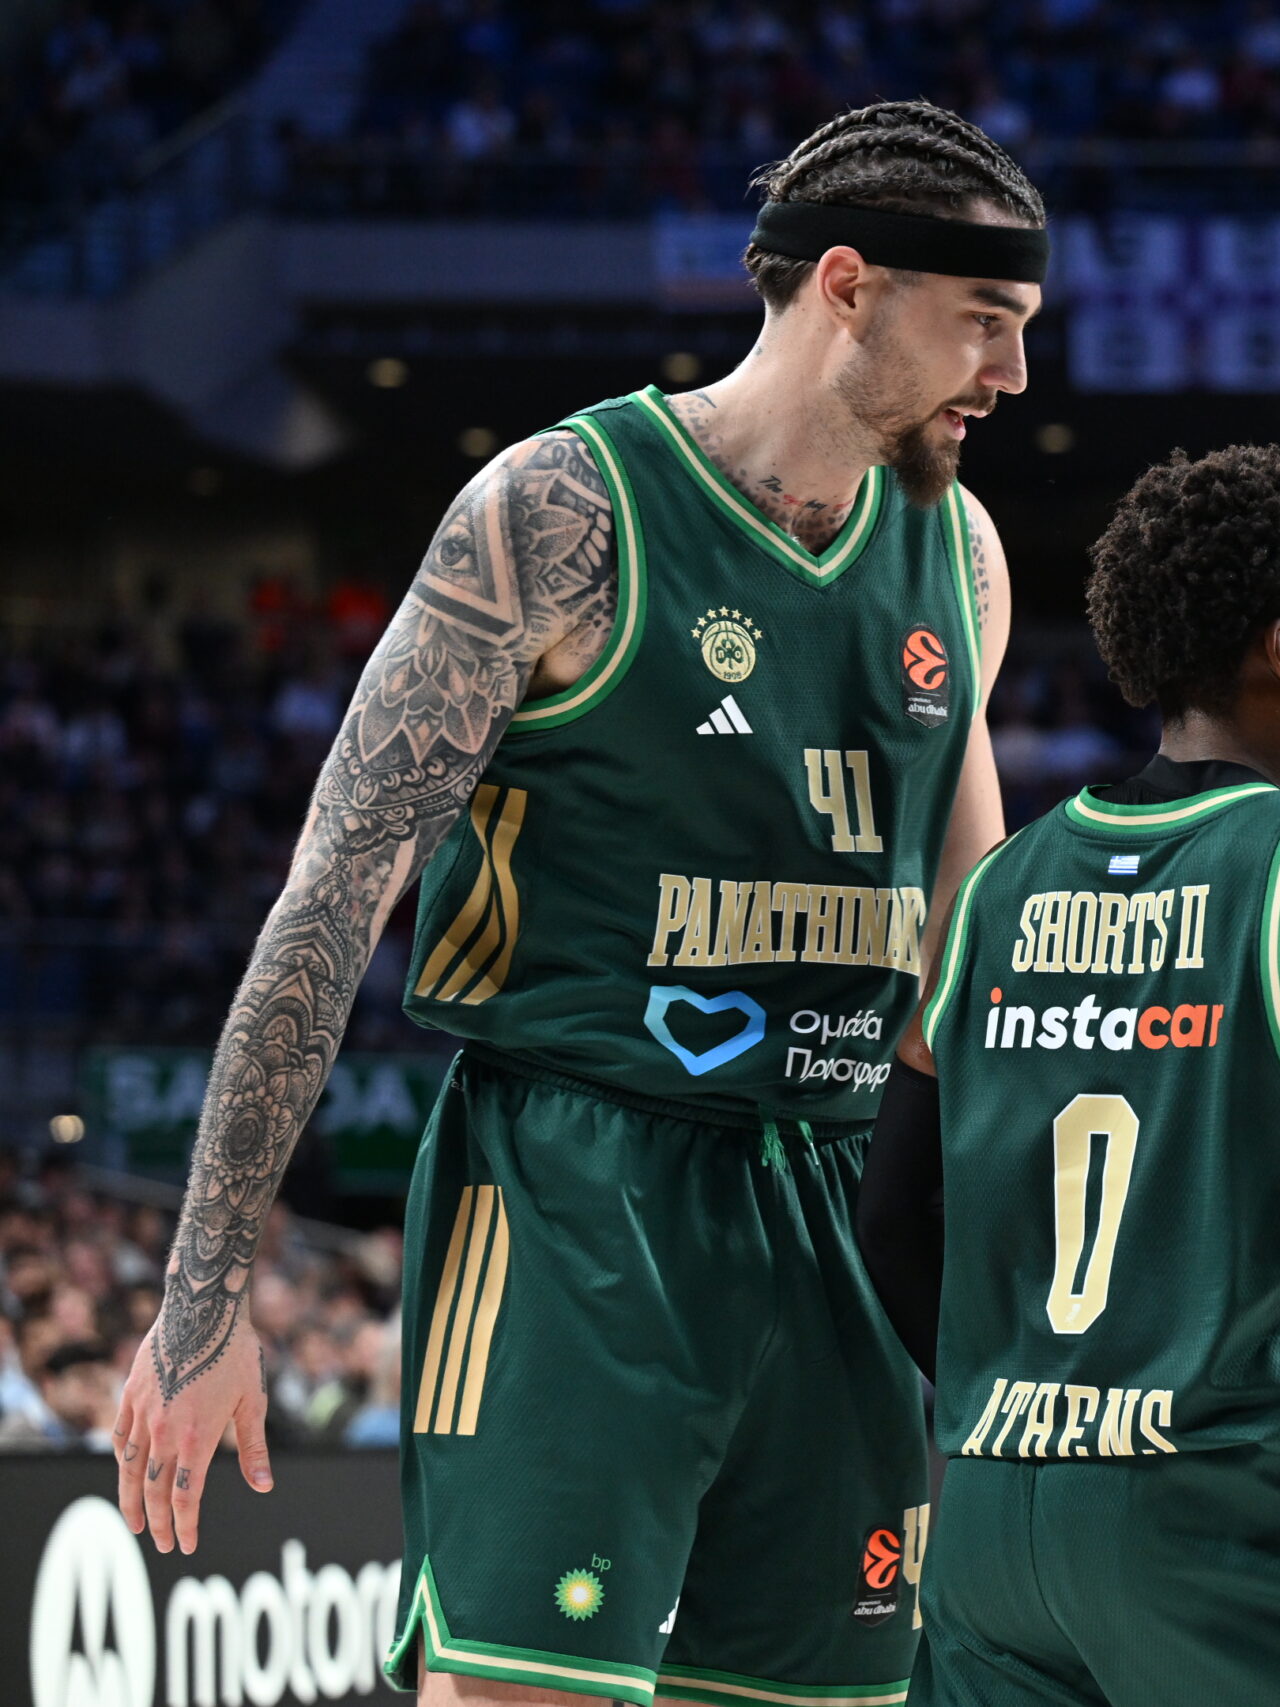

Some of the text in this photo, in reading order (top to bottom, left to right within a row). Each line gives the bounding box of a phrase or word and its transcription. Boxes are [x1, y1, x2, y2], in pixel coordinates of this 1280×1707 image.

[804, 748, 884, 853] 41
[1011, 884, 1210, 975] SHORTS II
[984, 986, 1225, 1051] instacar
[1046, 1093, 1140, 1334] 0
[961, 1377, 1179, 1458] ATHENS
[591, 1553, 612, 1573] bp
